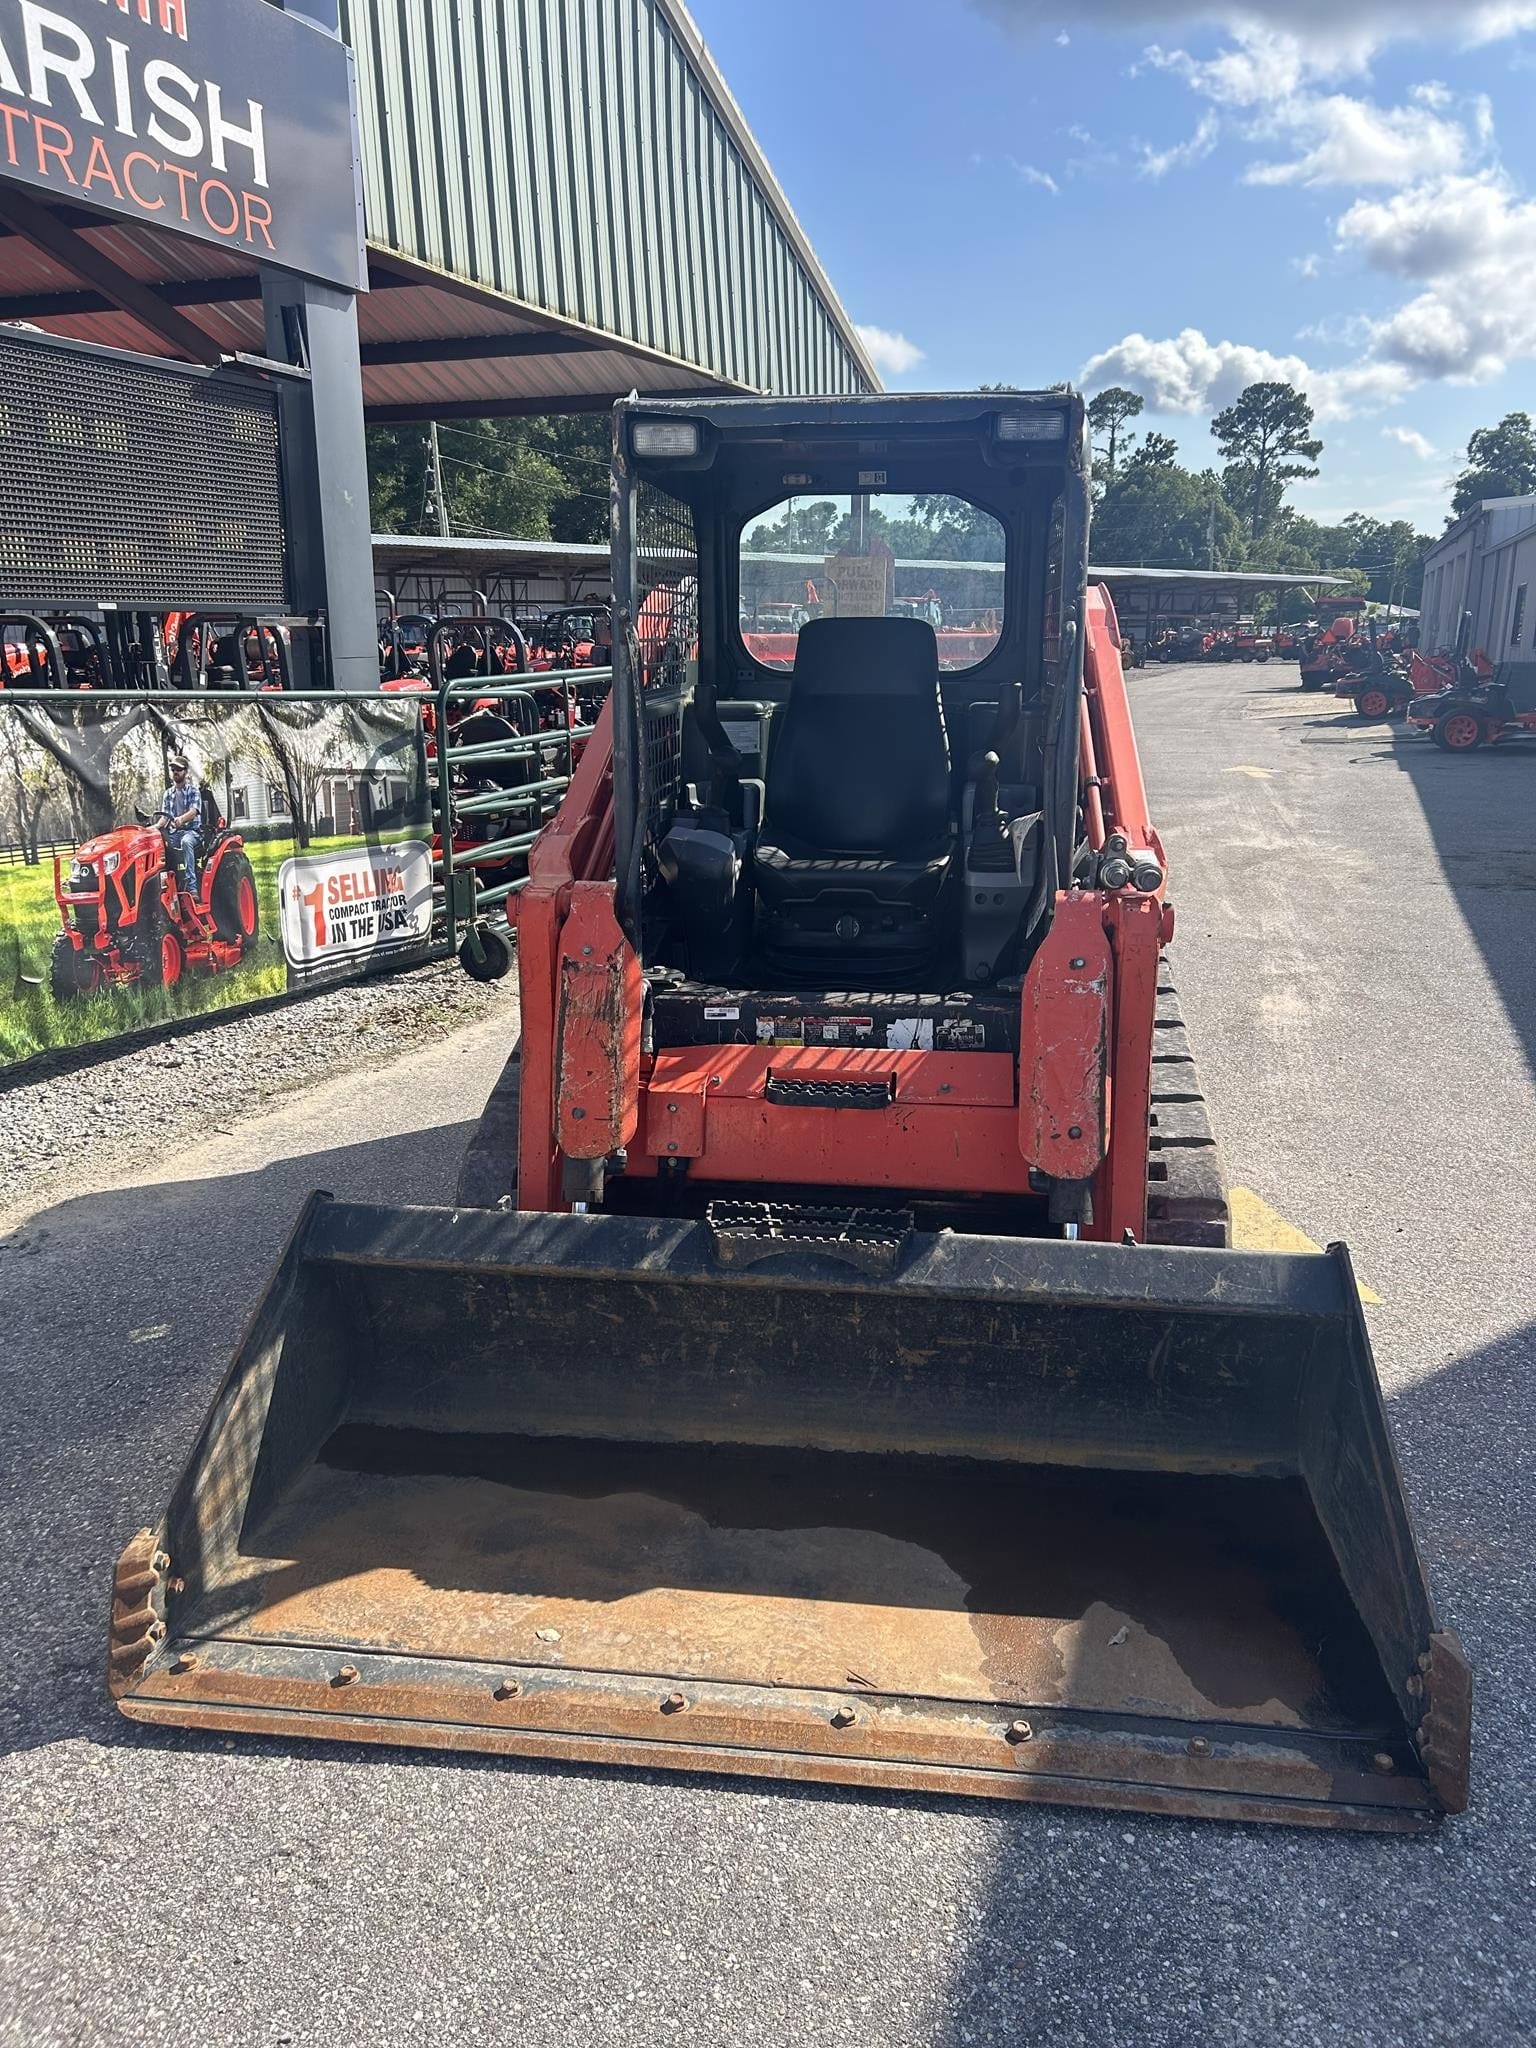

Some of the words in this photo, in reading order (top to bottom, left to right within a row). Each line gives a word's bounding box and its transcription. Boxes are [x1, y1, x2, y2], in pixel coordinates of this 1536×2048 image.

[0, 102, 276, 250] TRACTOR
[328, 865, 405, 905] SELLING
[329, 902, 370, 920] COMPACT
[372, 894, 407, 912] TRACTOR
[331, 922, 347, 944] IN
[350, 916, 374, 940] THE
